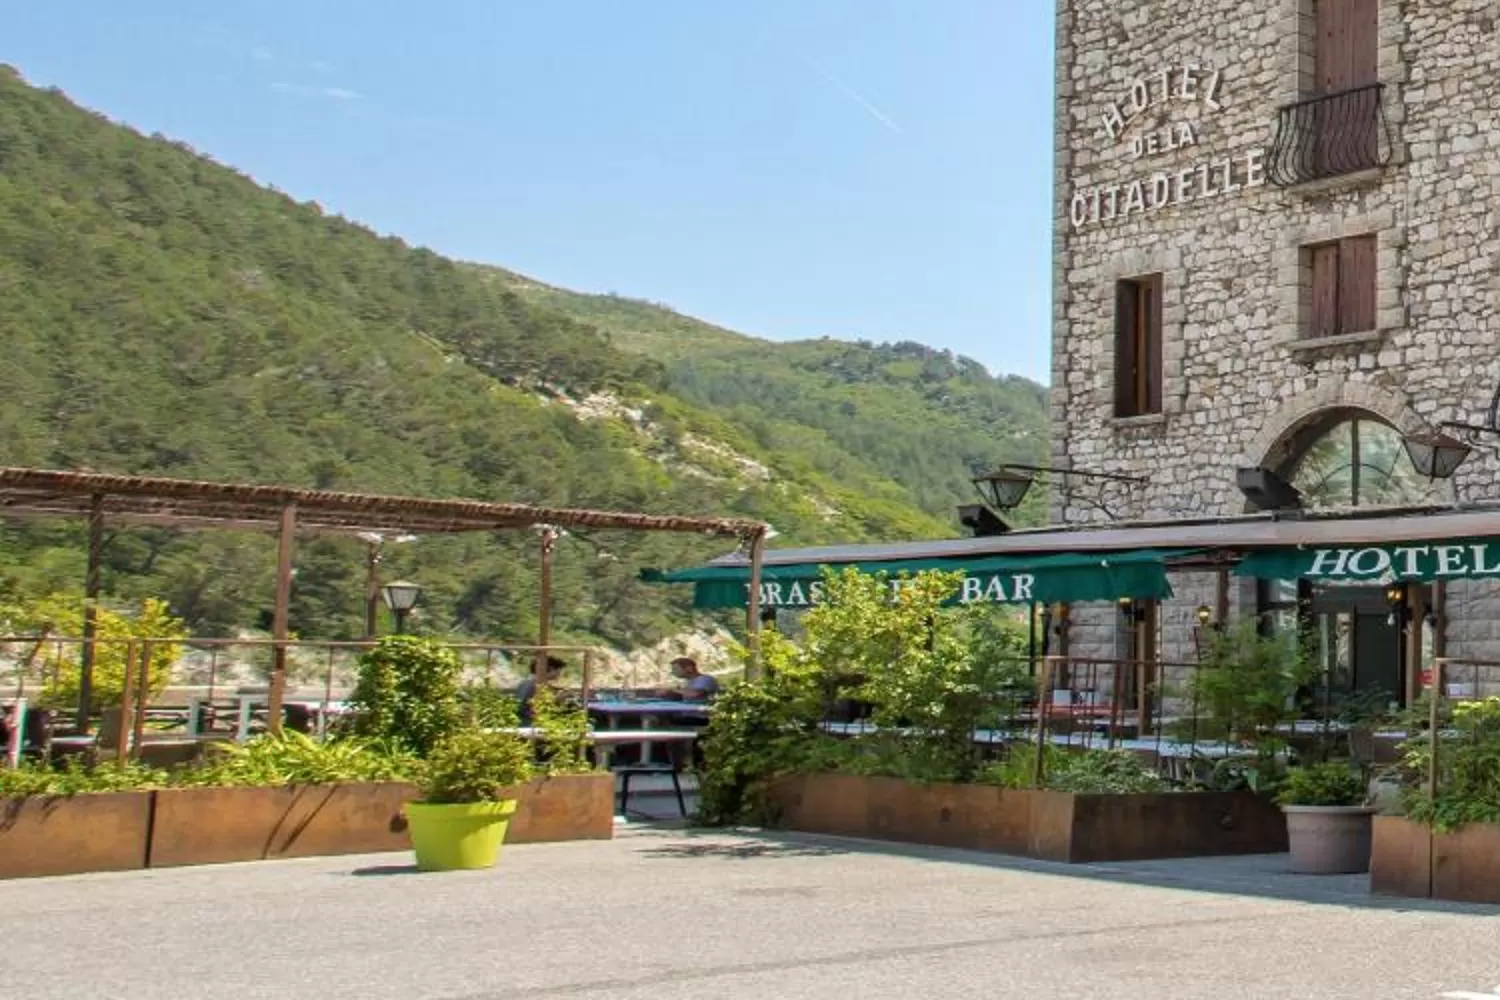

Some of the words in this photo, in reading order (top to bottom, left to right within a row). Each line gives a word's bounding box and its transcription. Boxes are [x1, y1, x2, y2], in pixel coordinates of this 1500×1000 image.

[1101, 62, 1222, 139] HOTEL
[1132, 134, 1159, 159] DE
[1165, 121, 1196, 149] LA
[1071, 147, 1266, 228] CITADELLE
[959, 573, 1036, 604] BAR
